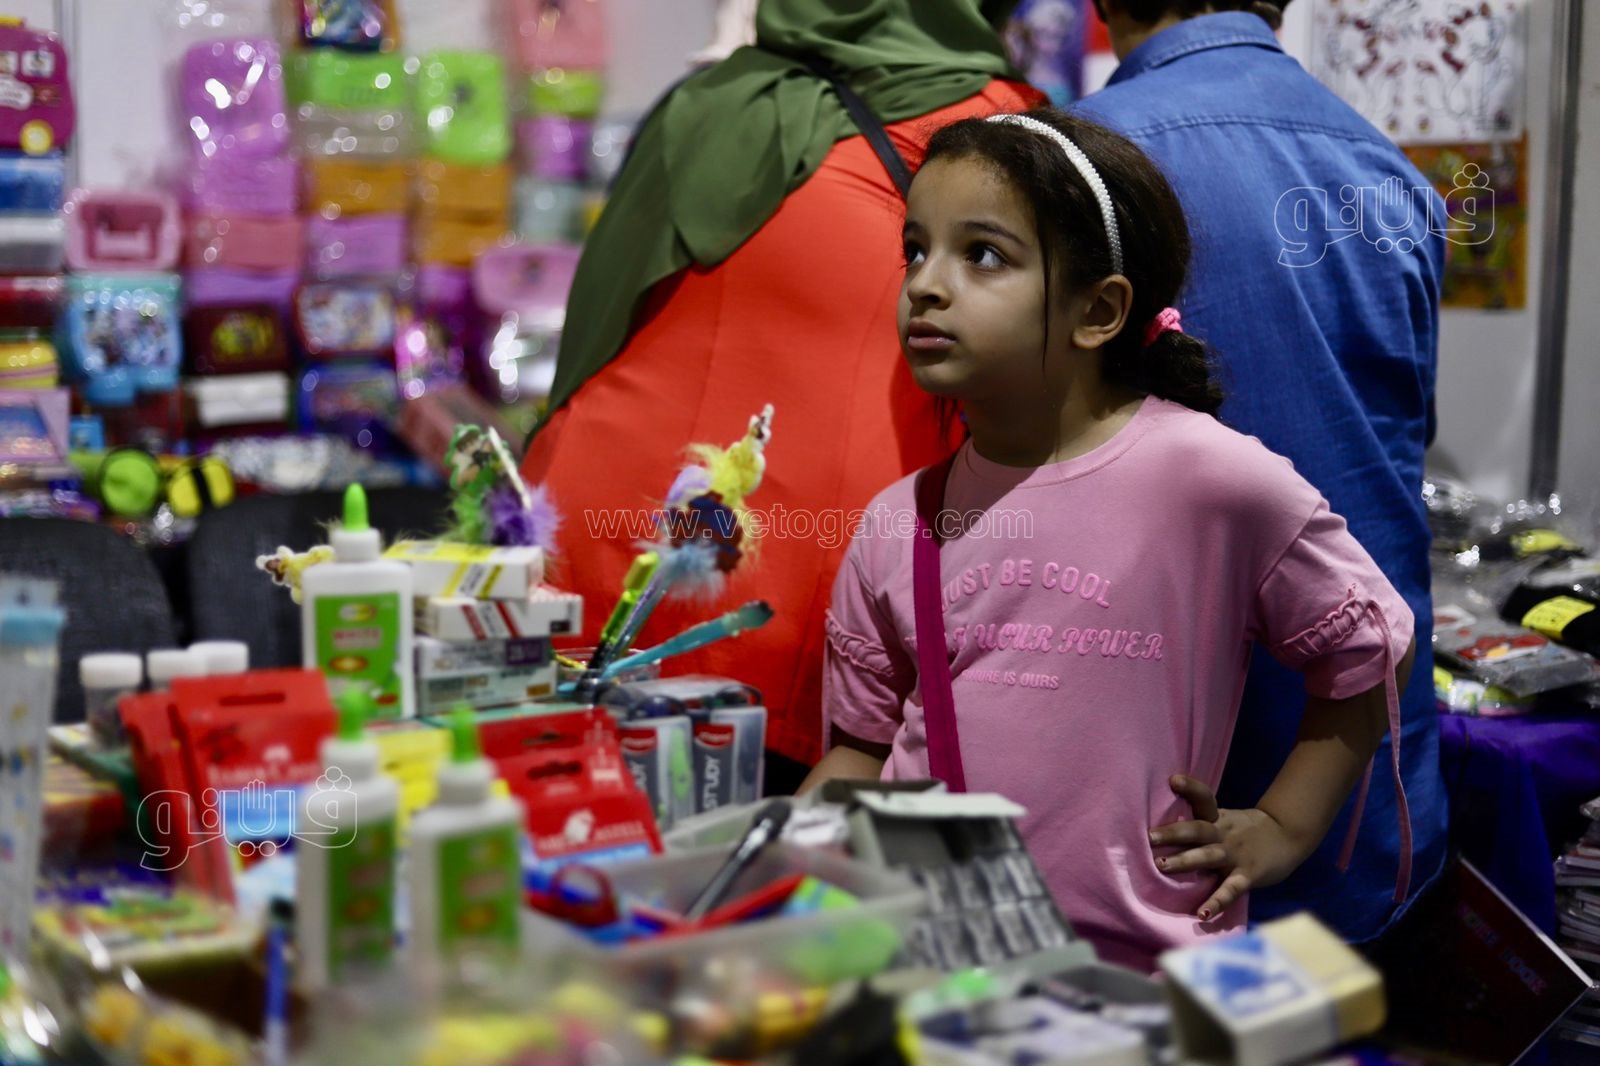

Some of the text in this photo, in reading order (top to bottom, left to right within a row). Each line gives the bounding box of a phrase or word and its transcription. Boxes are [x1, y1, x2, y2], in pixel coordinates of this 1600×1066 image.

[1000, 559, 1033, 587] BE
[1041, 561, 1112, 609] COOL
[1057, 626, 1164, 661] POWER
[1003, 670, 1018, 686] IS
[1020, 672, 1061, 690] OURS
